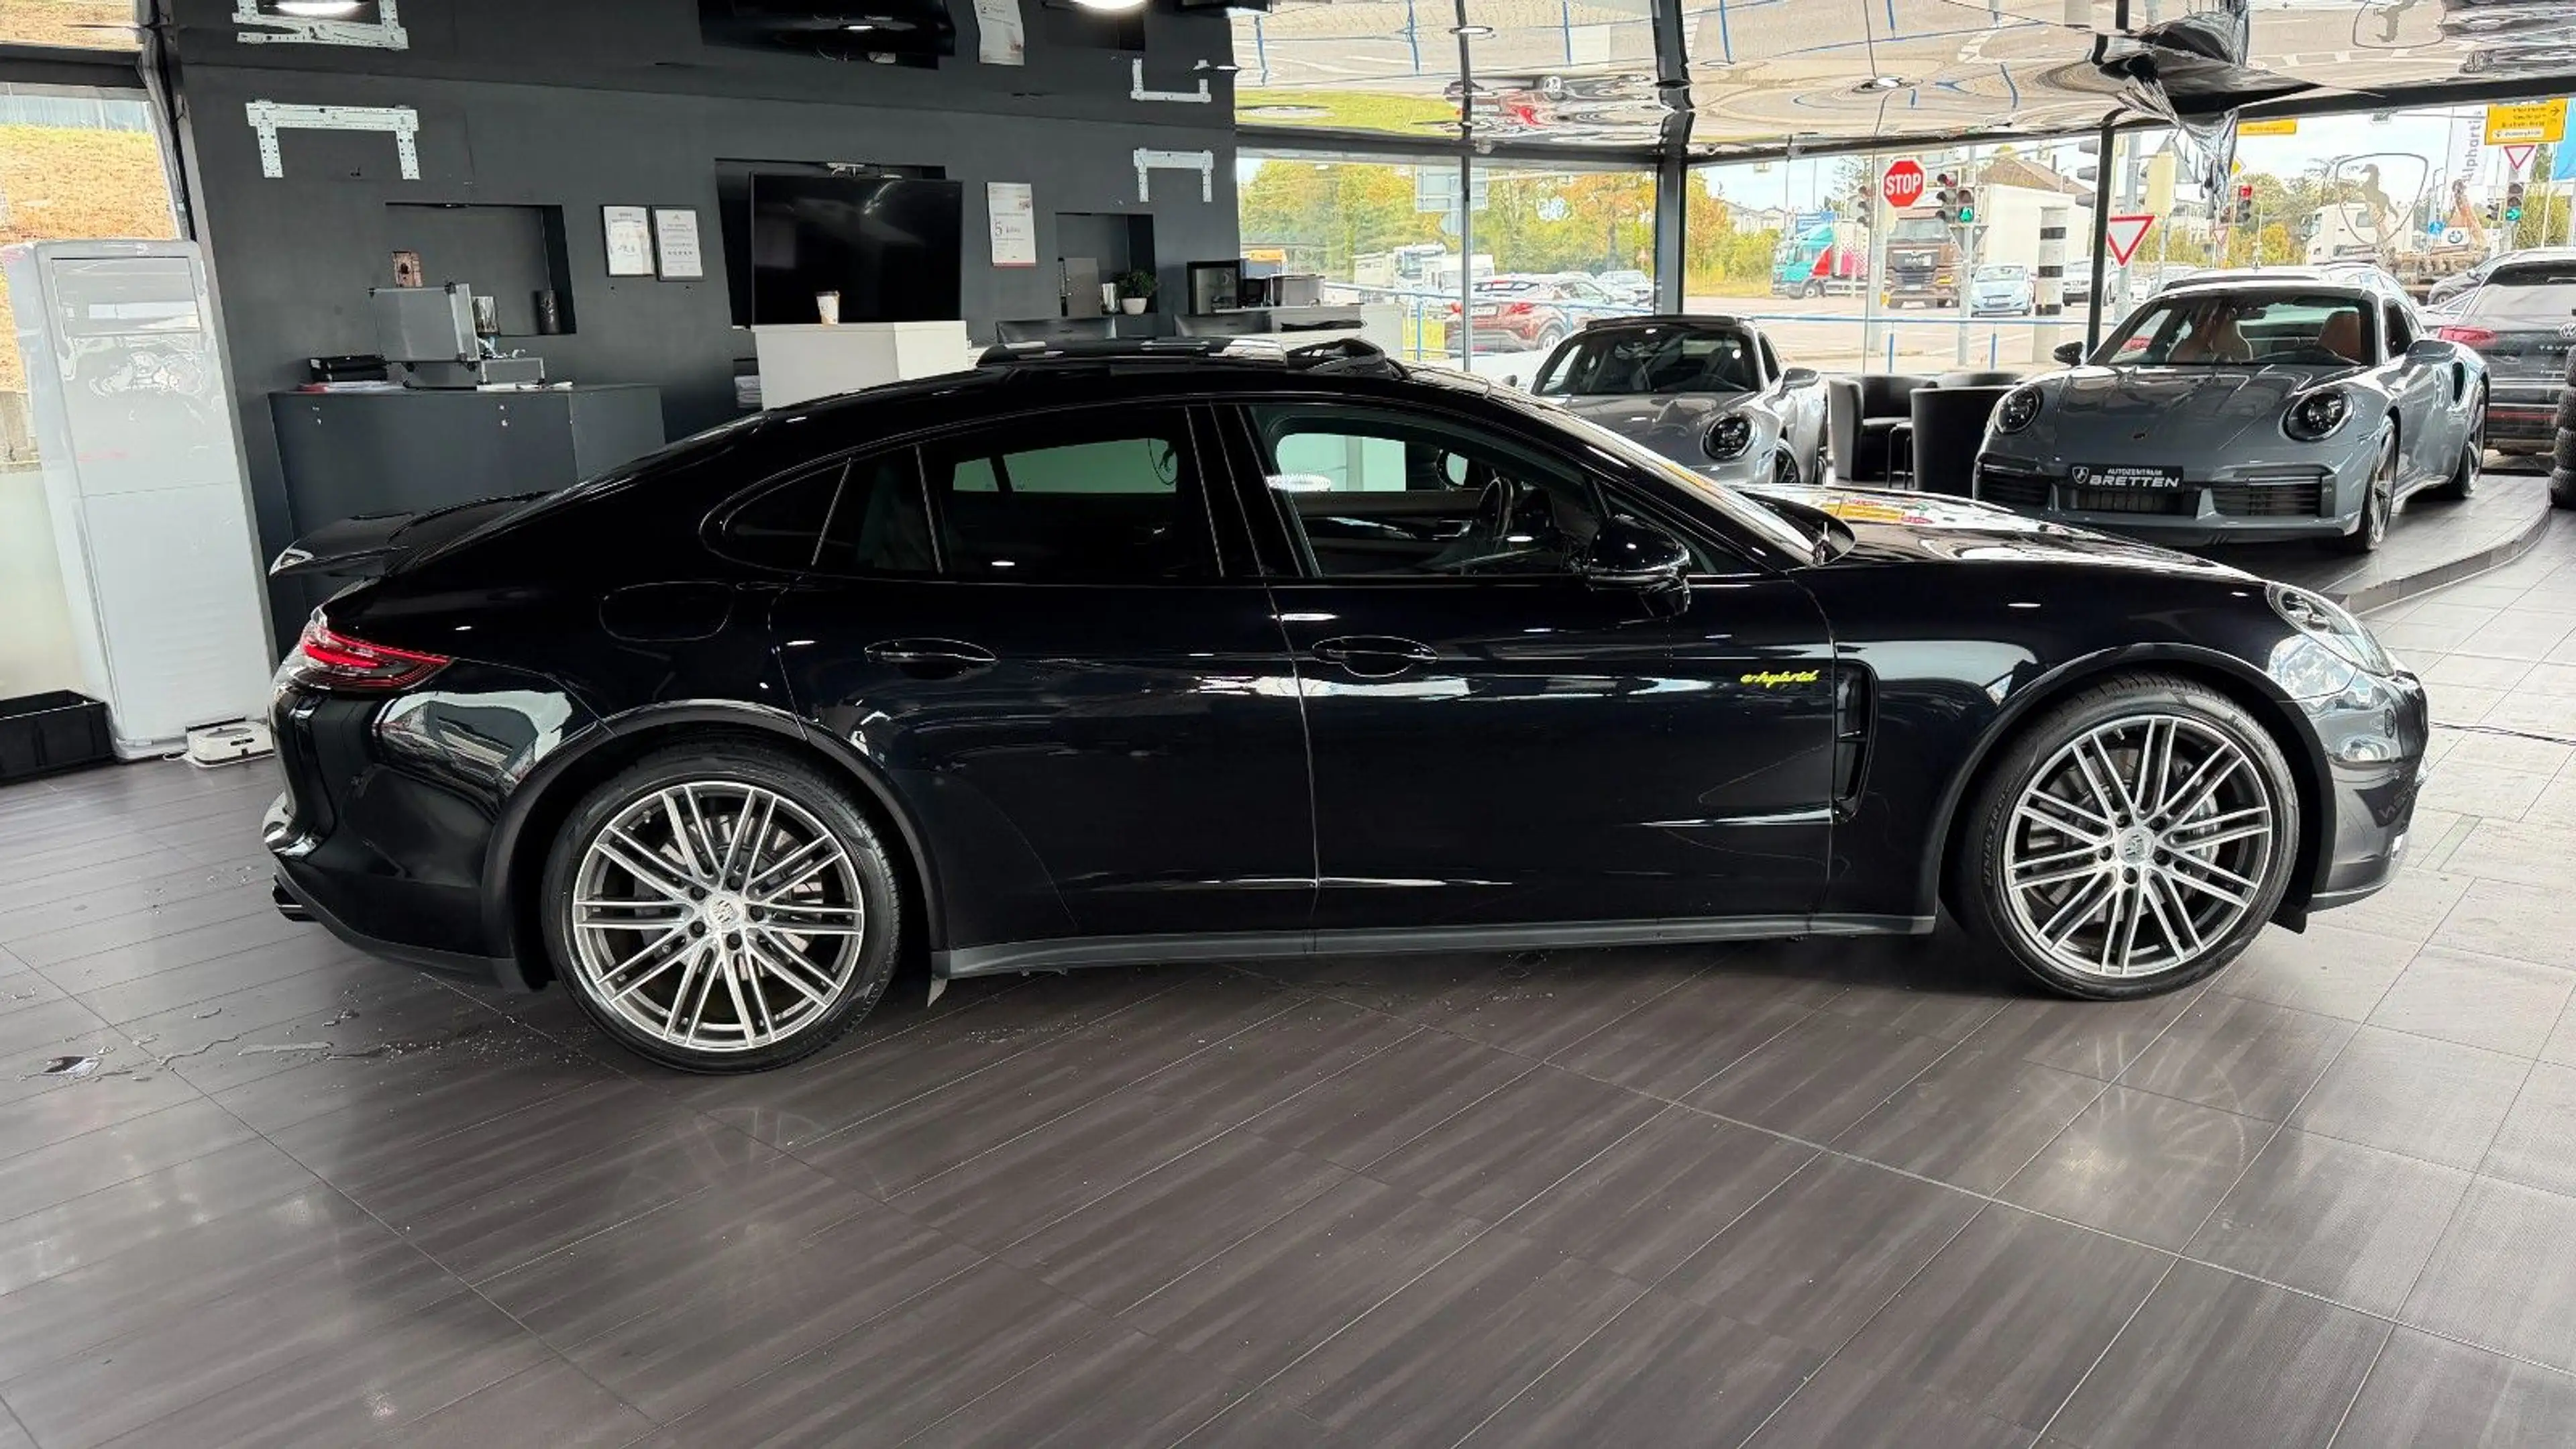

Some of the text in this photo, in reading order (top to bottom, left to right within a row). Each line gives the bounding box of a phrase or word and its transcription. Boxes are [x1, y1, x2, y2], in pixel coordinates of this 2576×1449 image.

[1886, 172, 1922, 196] STOP
[2089, 474, 2180, 488] BRETTEN
[1740, 669, 1820, 688] e-hybrid
